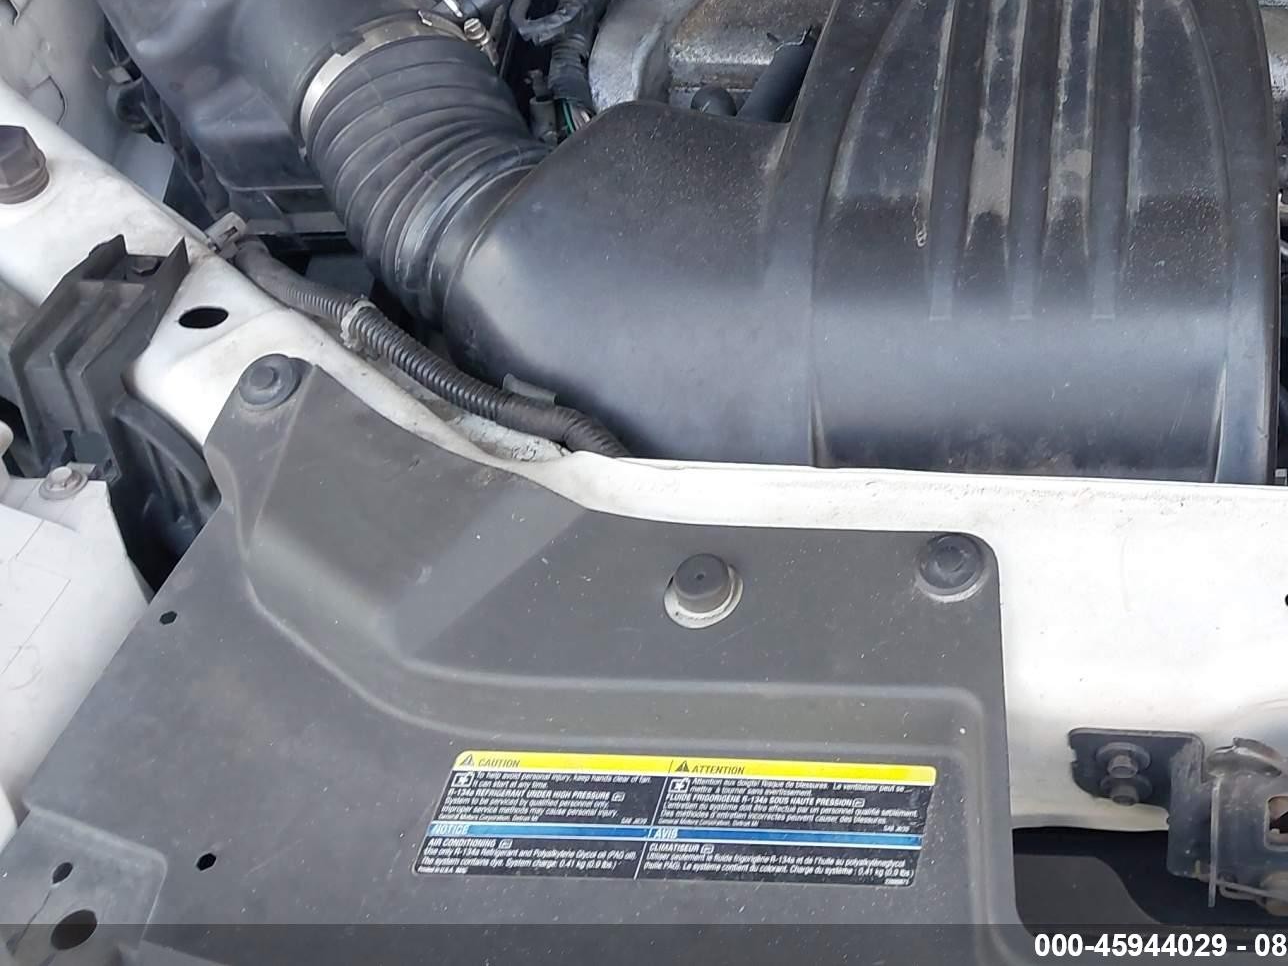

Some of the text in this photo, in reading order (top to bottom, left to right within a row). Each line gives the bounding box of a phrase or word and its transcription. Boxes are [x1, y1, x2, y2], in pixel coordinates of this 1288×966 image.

[477, 758, 521, 767] CAUTION
[692, 765, 745, 774] ATTENTION
[521, 772, 551, 781] personal
[573, 774, 591, 782] keep
[517, 781, 531, 789] any
[475, 788, 525, 797] REFRIGERANT
[526, 790, 552, 798] UNDER
[552, 790, 572, 798] HIGH
[572, 791, 610, 799] PRESSURE
[489, 797, 519, 805] serviced
[519, 798, 528, 806] by
[528, 798, 559, 807] qualified
[559, 800, 593, 808] personnel
[666, 793, 691, 801] FLUIDE
[769, 796, 789, 804] SOUS
[790, 797, 814, 805] HAUTE
[816, 797, 852, 806] PRESSION
[498, 806, 529, 814] methods
[566, 808, 597, 817] personal
[797, 806, 809, 814] par
[820, 806, 854, 815] personnel
[786, 814, 814, 822] peuvent
[432, 823, 470, 835] NOTICE
[654, 827, 678, 838] AVIS
[428, 838, 497, 847] AIR CONDITIONING
[650, 843, 700, 852] CLIMATISEUR
[438, 848, 454, 857] only
[519, 849, 533, 857] and
[434, 858, 460, 866] system
[460, 858, 490, 866] contains
